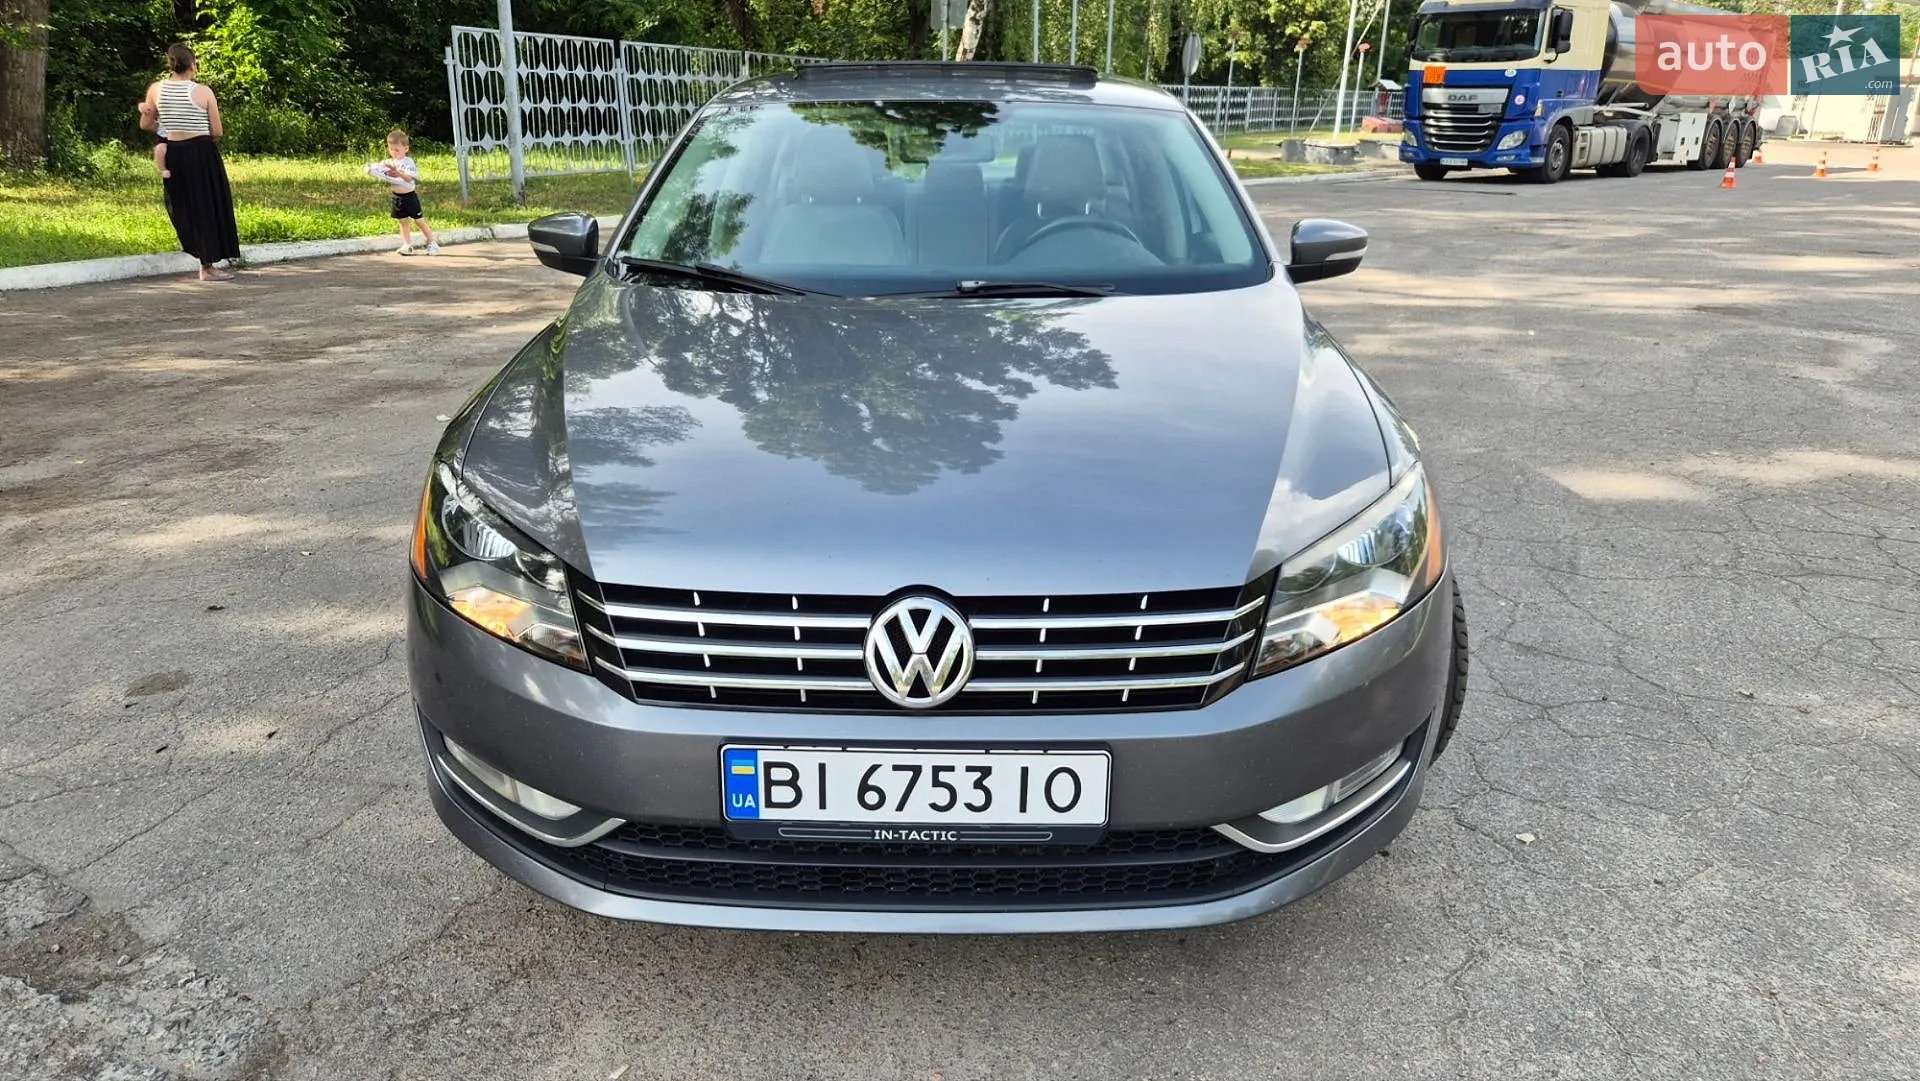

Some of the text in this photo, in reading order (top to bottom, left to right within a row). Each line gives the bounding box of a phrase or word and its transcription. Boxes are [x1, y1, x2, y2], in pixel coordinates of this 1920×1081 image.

[1447, 94, 1478, 102] DAF
[857, 763, 992, 813] 6753
[732, 793, 756, 808] UA
[873, 829, 958, 841] IN-TACTIC
